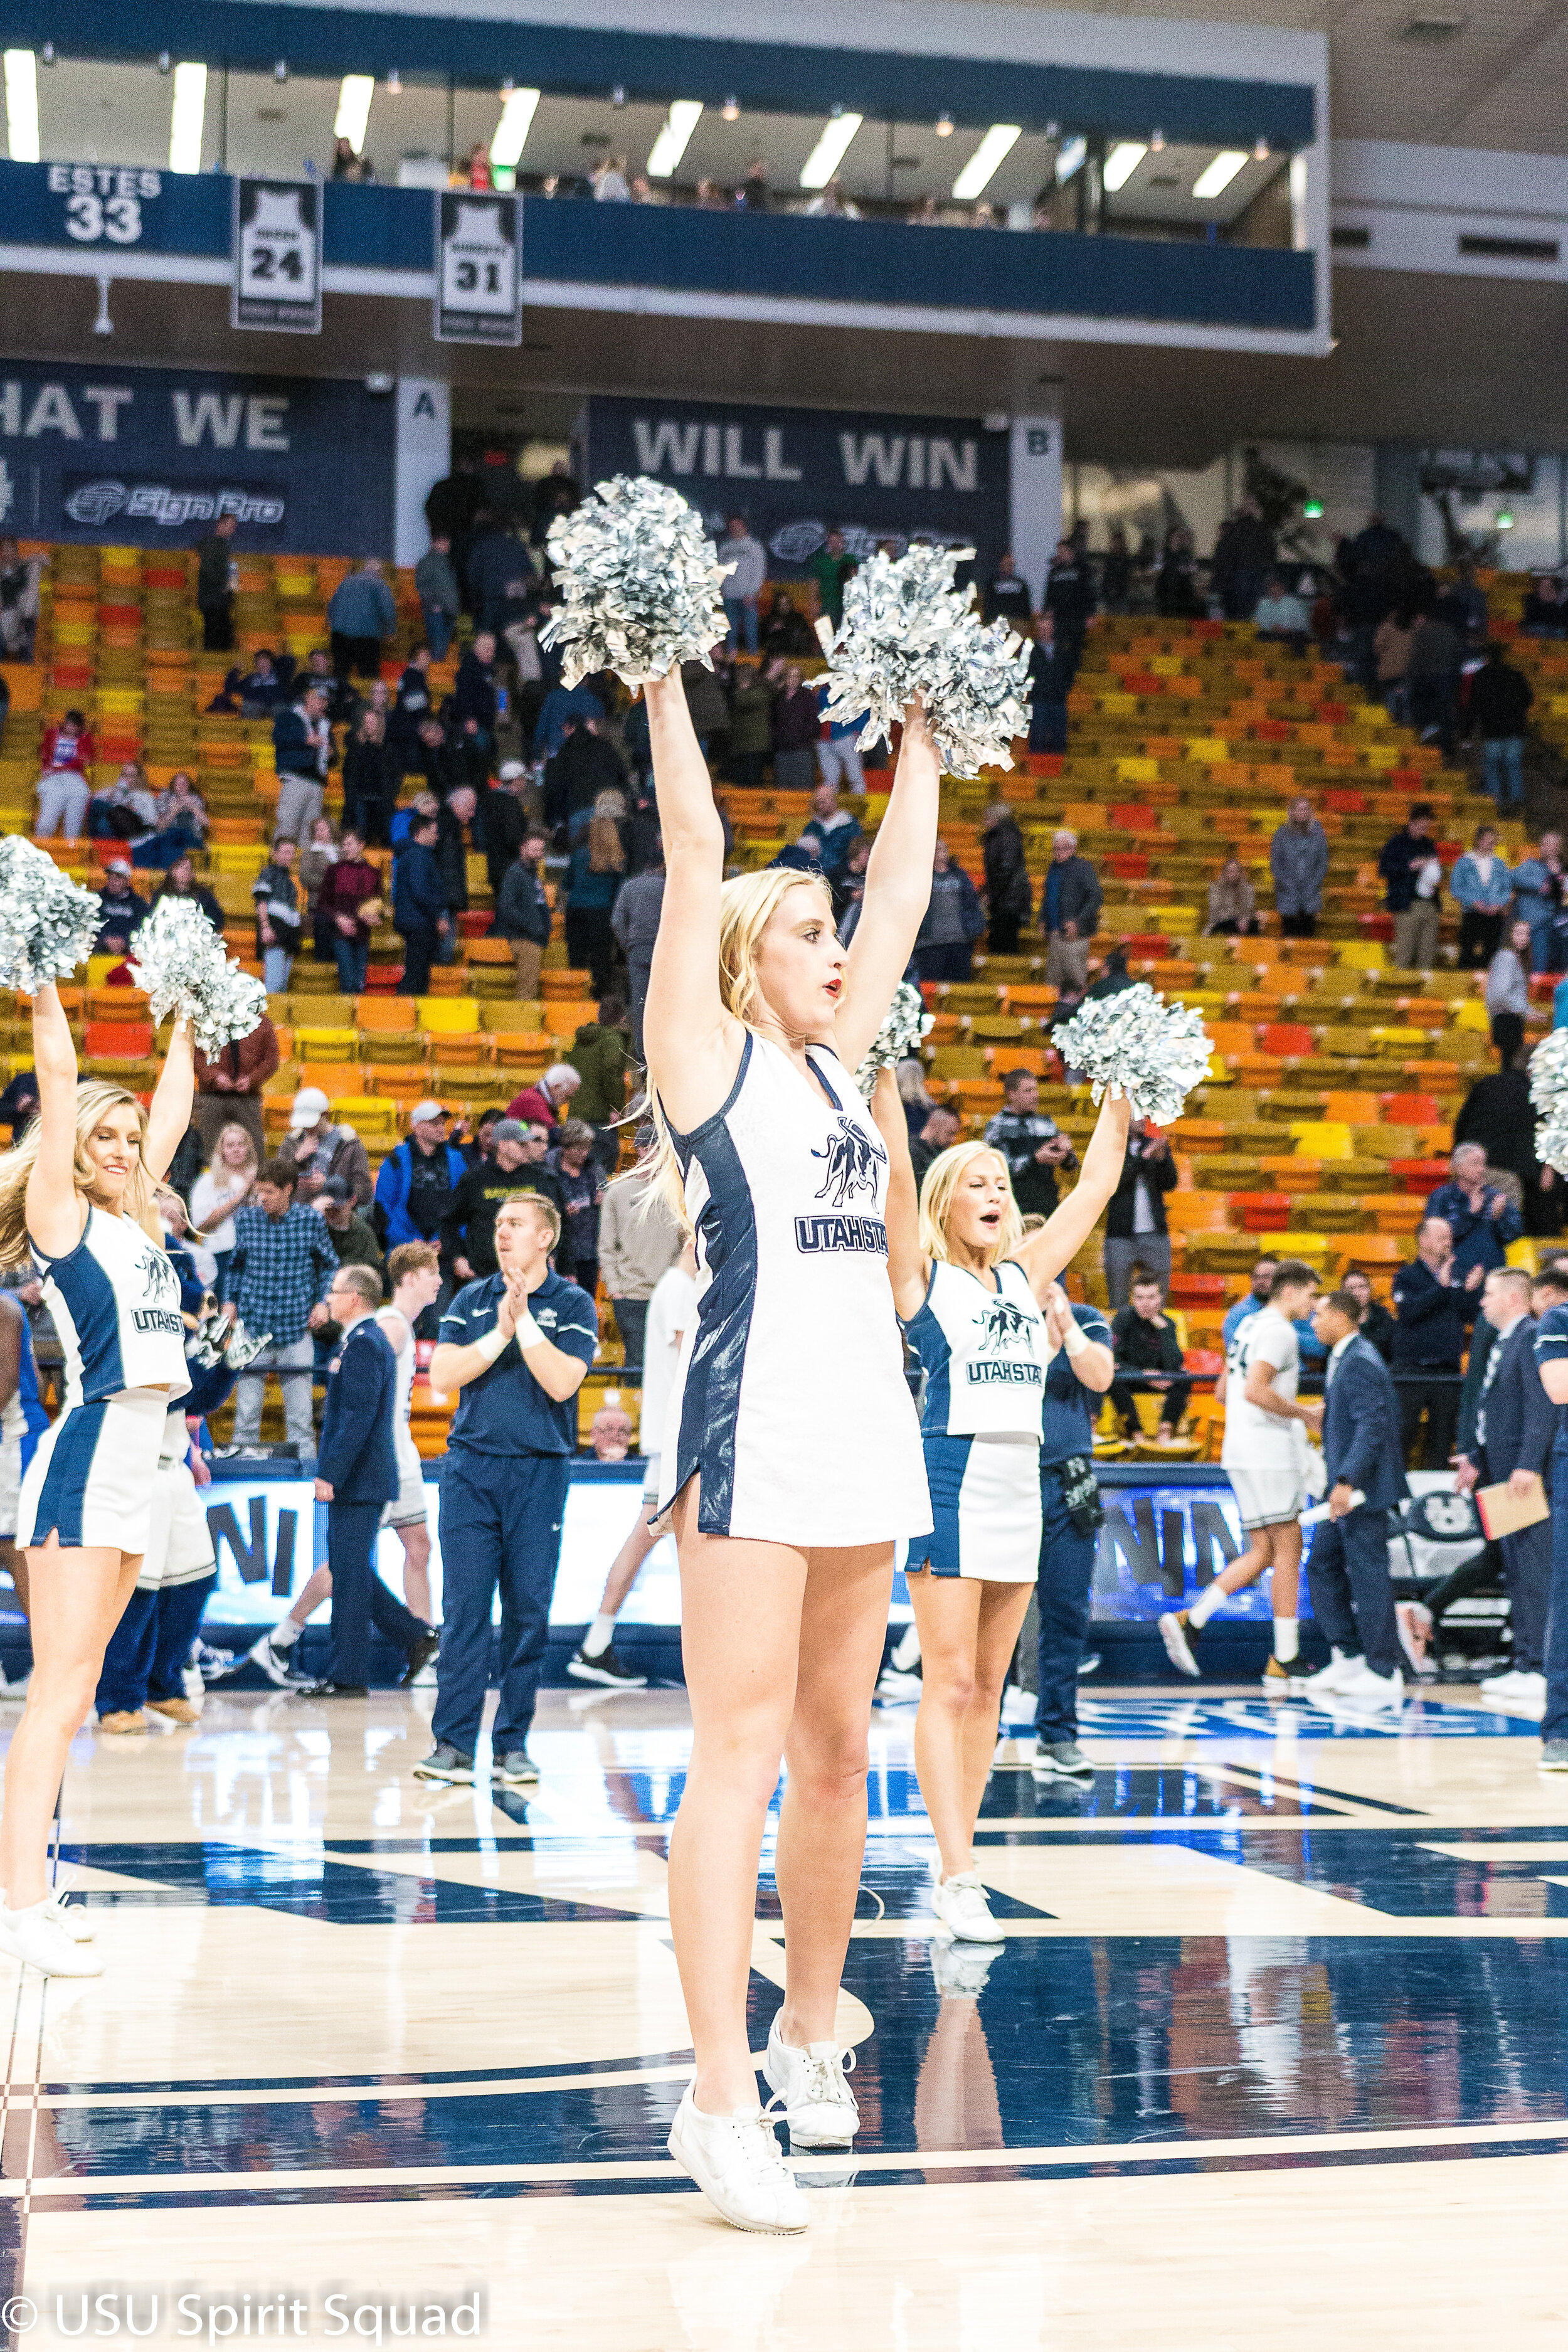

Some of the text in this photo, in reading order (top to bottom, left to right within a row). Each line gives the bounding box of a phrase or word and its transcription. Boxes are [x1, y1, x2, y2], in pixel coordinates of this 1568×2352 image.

[48, 166, 161, 199] ESTES
[66, 195, 142, 243] 33
[252, 246, 302, 282] 24
[456, 260, 500, 295] 31
[172, 390, 290, 452] WE
[413, 391, 437, 420] A
[632, 419, 979, 492] WILL WIN
[1027, 429, 1049, 456] B
